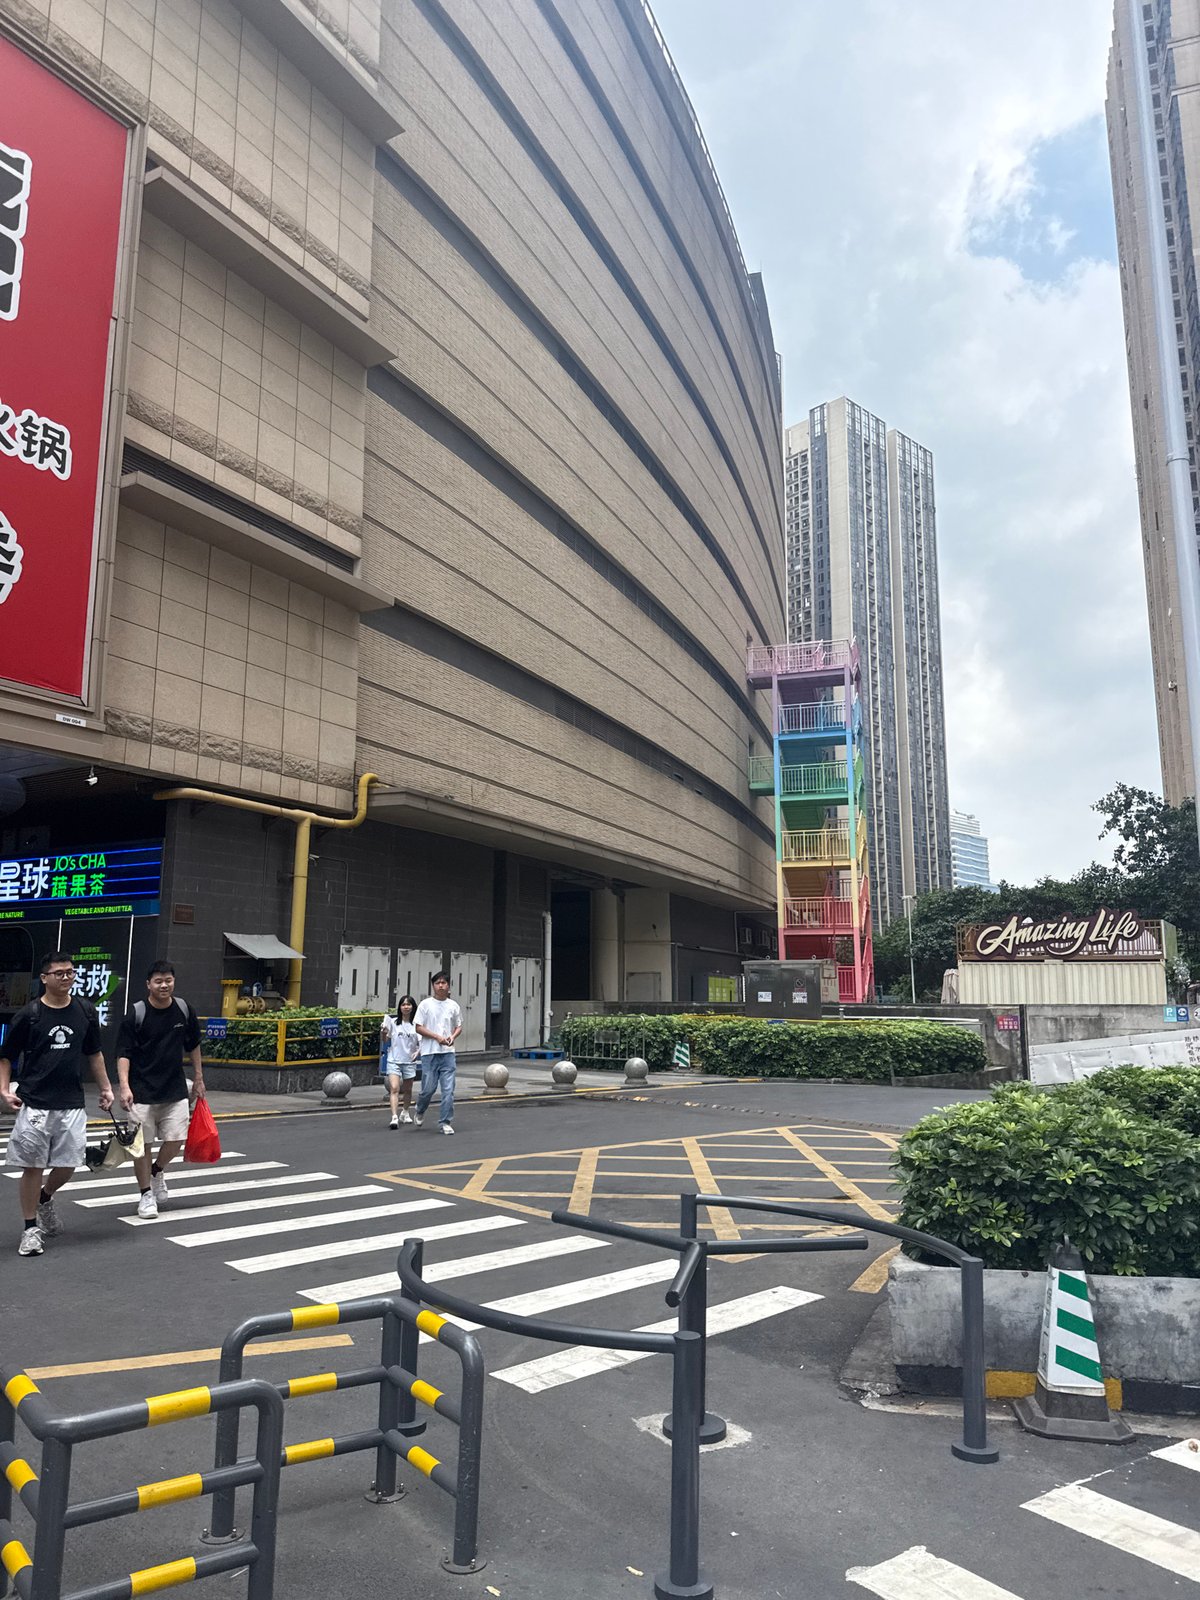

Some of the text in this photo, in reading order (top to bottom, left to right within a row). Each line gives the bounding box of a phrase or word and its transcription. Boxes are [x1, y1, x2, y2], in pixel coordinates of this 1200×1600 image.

[78, 853, 106, 870] CHA
[51, 873, 106, 898] 蔬果茶
[976, 908, 1139, 956] Amazing Life
